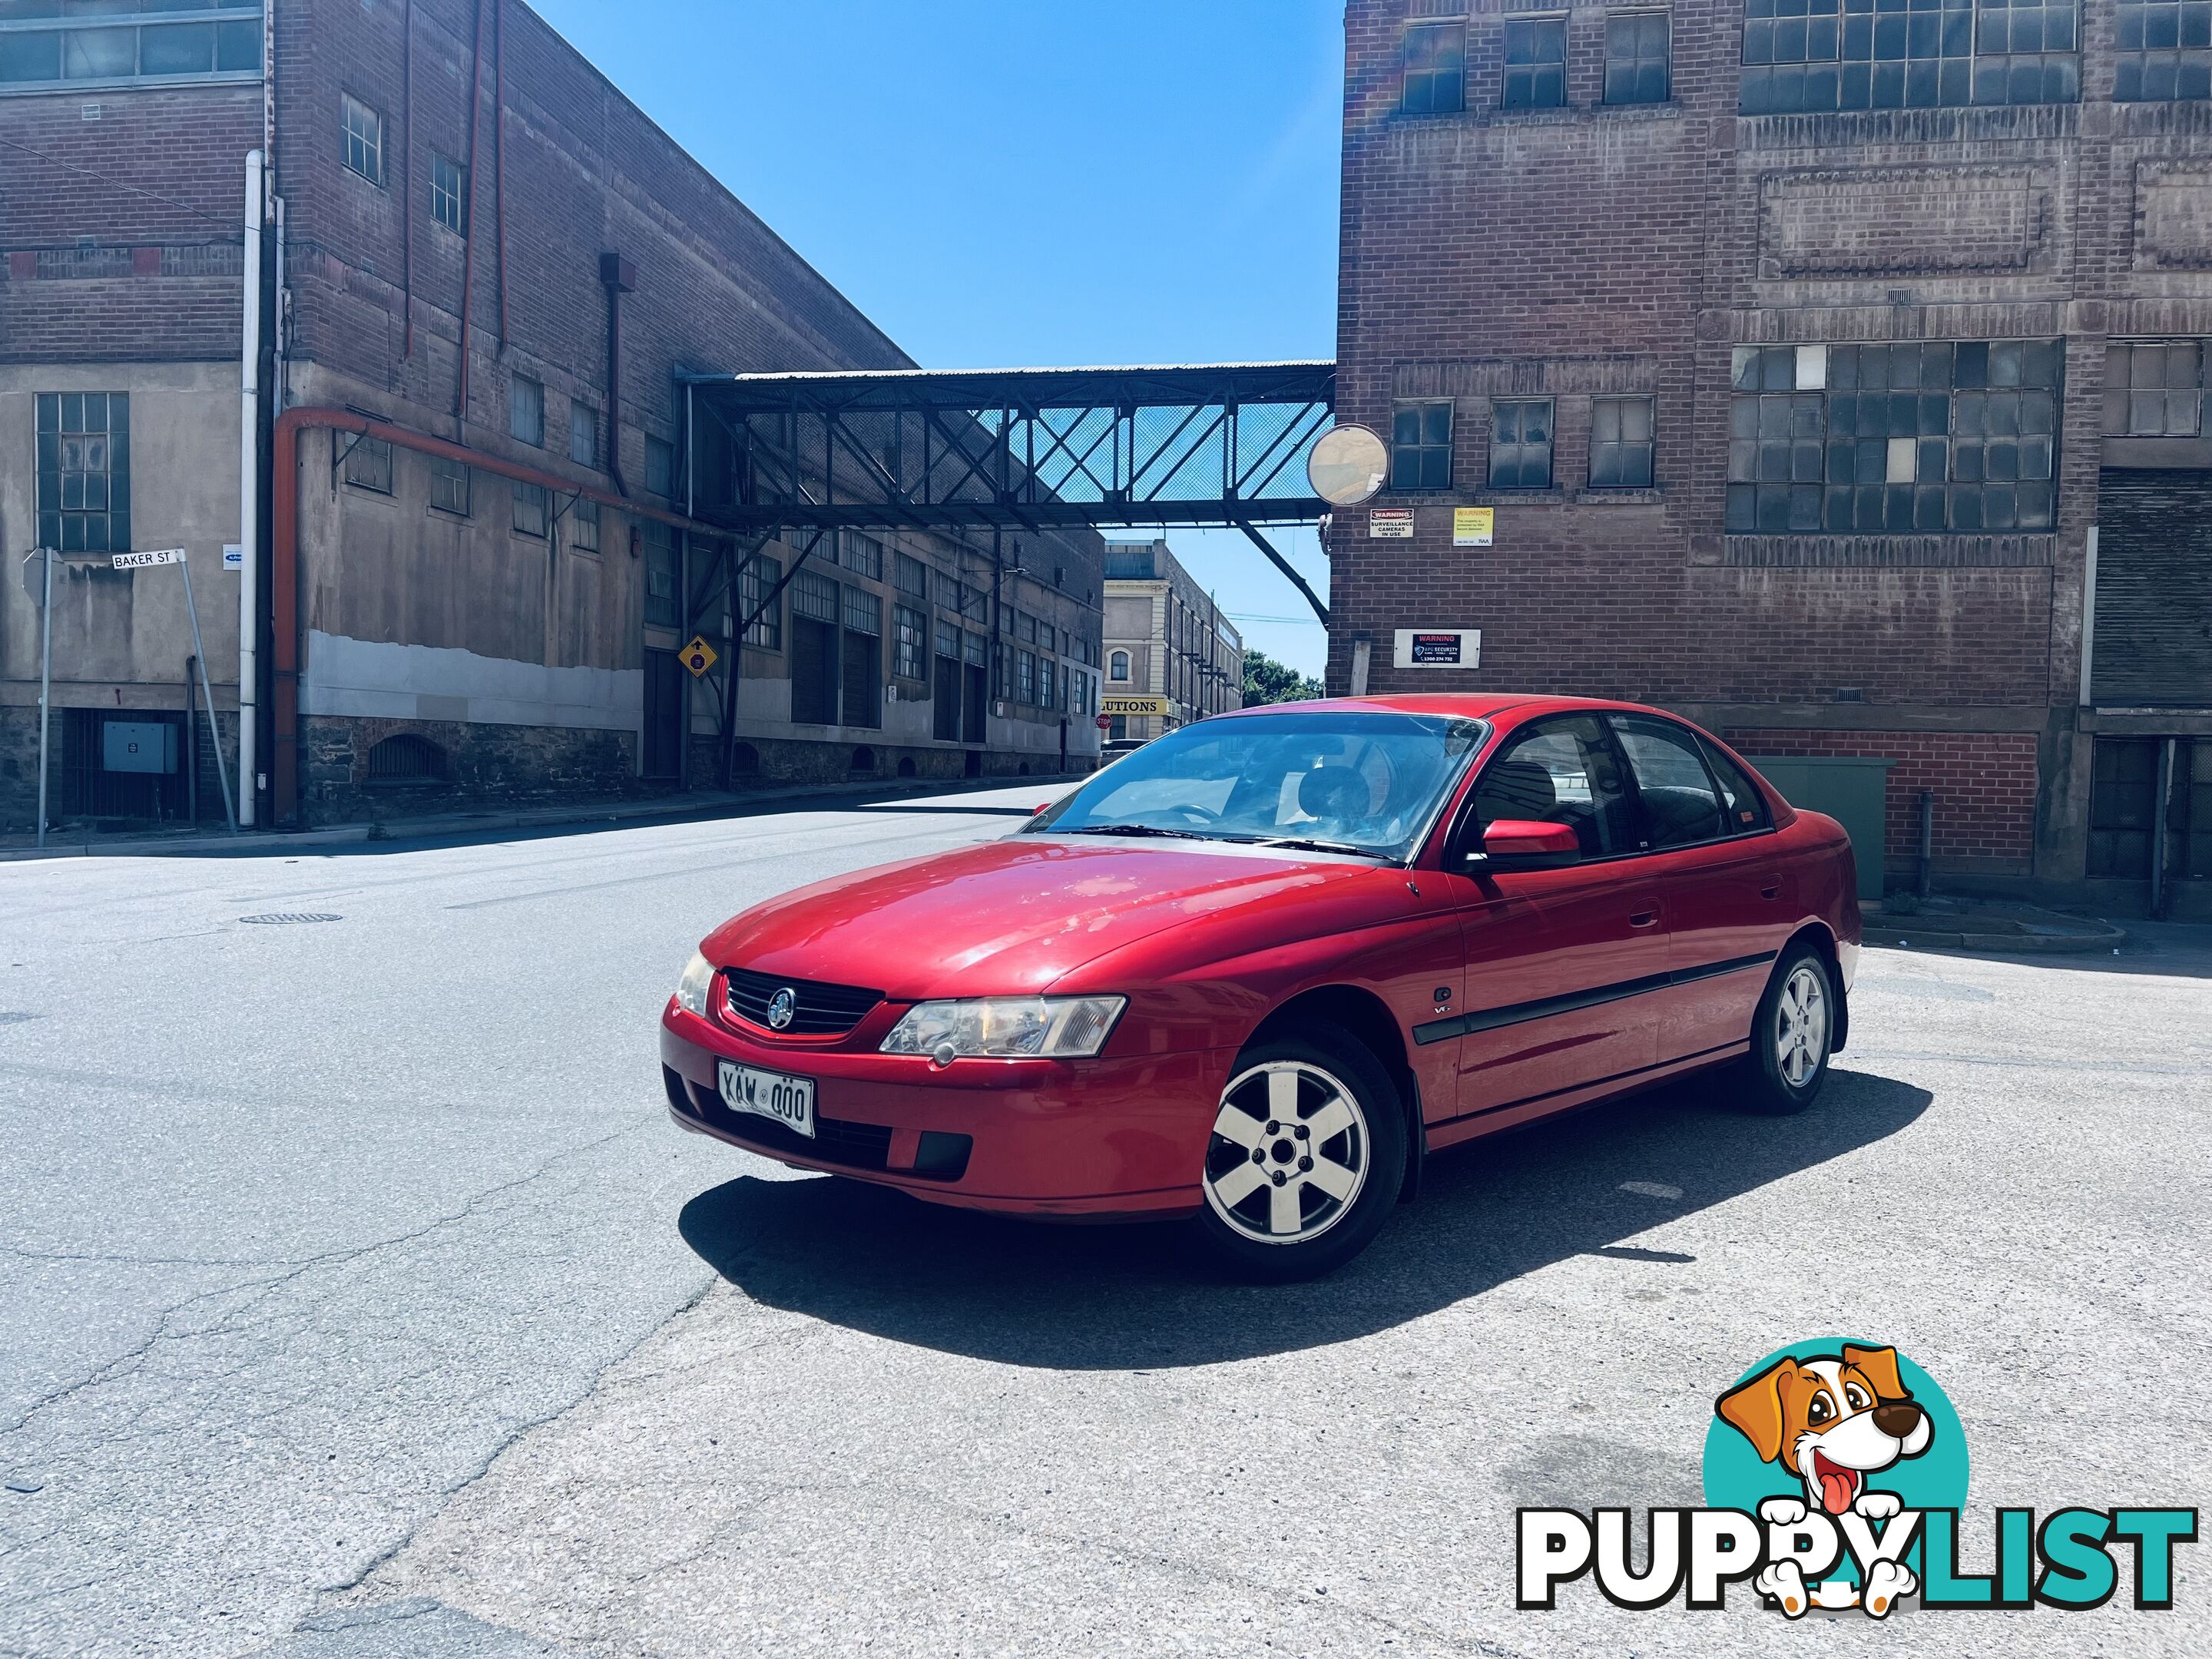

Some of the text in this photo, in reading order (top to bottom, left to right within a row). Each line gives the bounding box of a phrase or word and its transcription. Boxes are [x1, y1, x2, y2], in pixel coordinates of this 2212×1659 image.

[114, 551, 171, 567] BAKER ST
[1096, 717, 1111, 726] STOP
